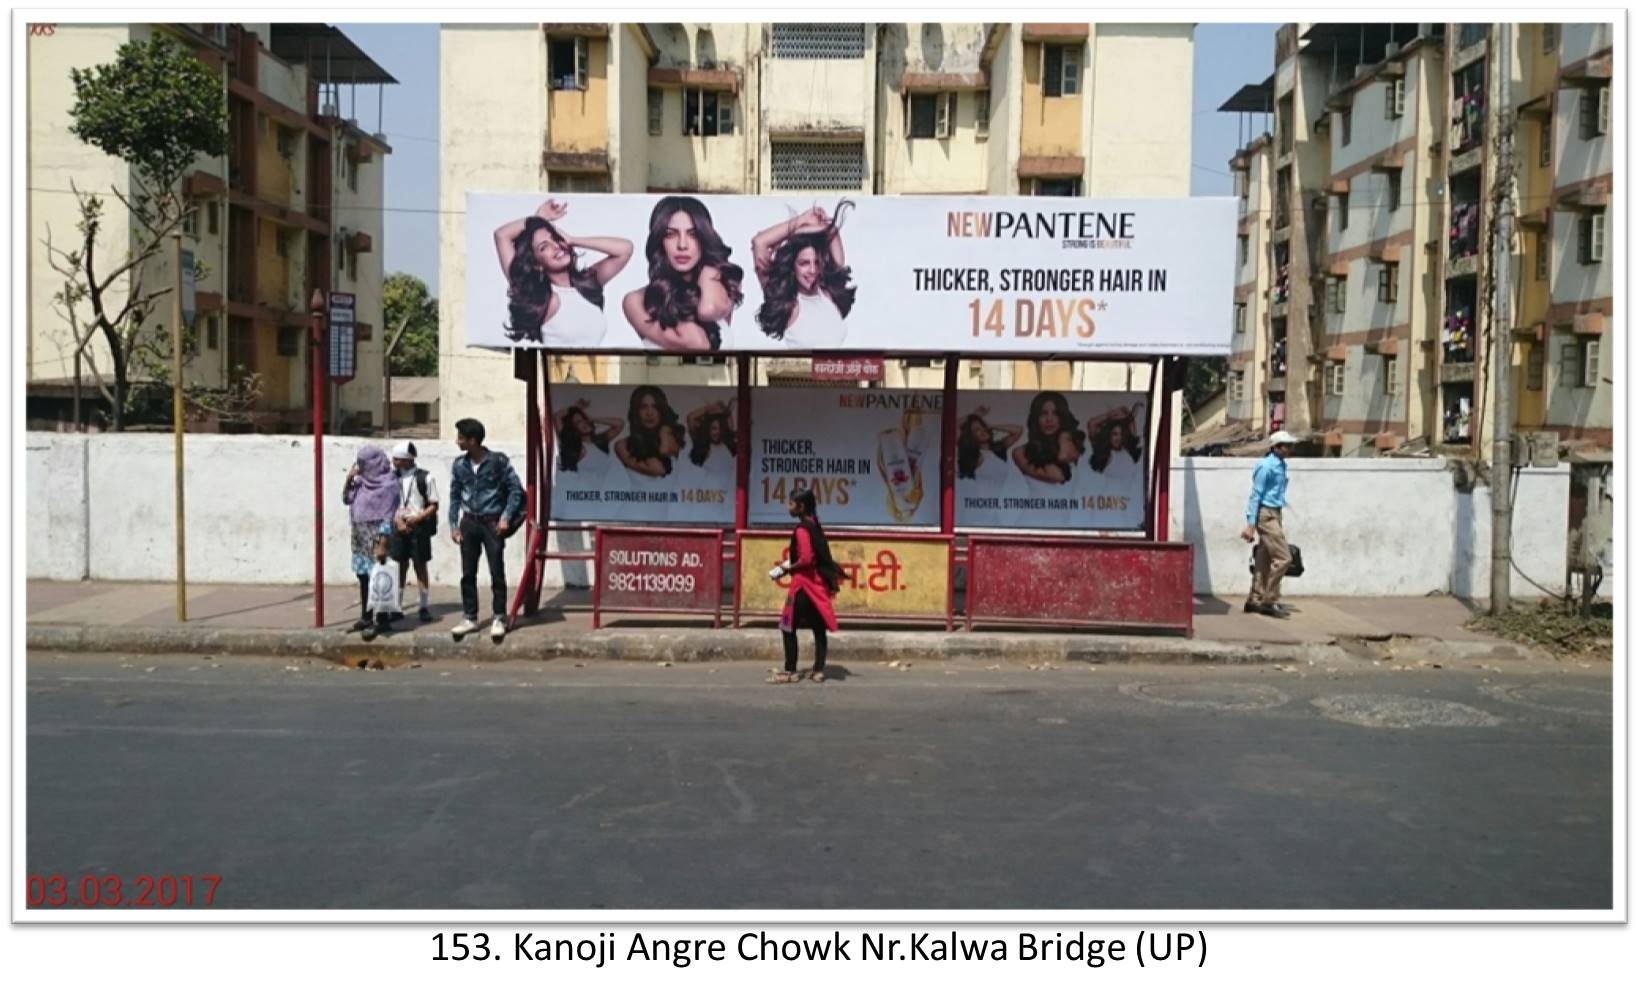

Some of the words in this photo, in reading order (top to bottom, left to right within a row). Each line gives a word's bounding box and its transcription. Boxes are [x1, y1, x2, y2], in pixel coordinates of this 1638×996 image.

[947, 212, 993, 237] NEW
[995, 212, 1136, 239] PANTENE
[913, 268, 994, 293] THICKER,
[1000, 268, 1094, 292] STRONGER
[1099, 269, 1143, 292] HAIR
[1148, 269, 1167, 292] IN
[968, 298, 1005, 338] 14
[840, 393, 864, 408] NEW
[866, 392, 945, 409] PANTENE
[762, 439, 816, 456] THICKER,
[761, 457, 824, 474] STRONGER
[826, 458, 855, 475] HAIR
[858, 458, 871, 475] IN
[566, 490, 603, 503] THICKER,
[604, 490, 647, 503] STRONGER
[649, 491, 669, 503] HAIR
[669, 492, 679, 503] IN
[681, 488, 695, 503] 14
[761, 476, 786, 505] 14
[1003, 497, 1046, 510] STRONGER
[1048, 498, 1069, 510] HAIR
[1069, 498, 1079, 510] IN
[1082, 495, 1096, 511] 14
[608, 549, 678, 567] SOLUTIONS
[681, 552, 704, 568] AD.
[608, 571, 696, 593] 9821139099
